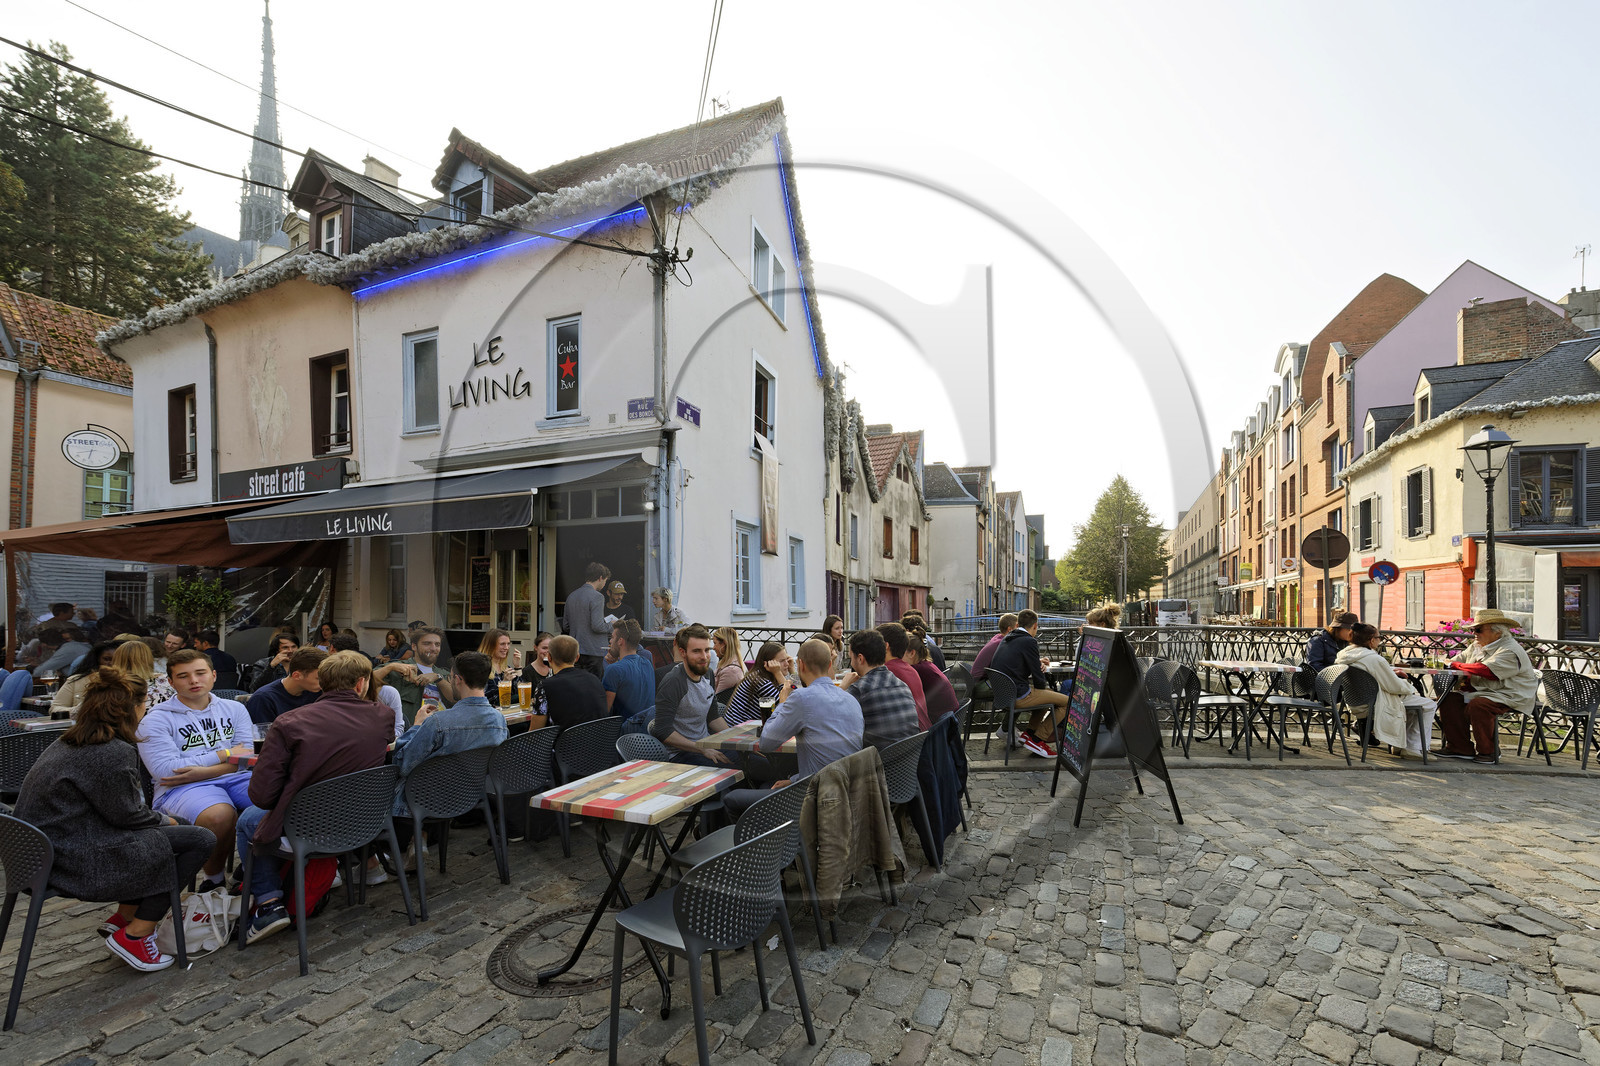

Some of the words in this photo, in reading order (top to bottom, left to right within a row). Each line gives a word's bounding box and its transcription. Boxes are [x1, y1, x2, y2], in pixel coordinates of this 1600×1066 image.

[473, 335, 505, 368] LE
[557, 341, 579, 355] Cuba
[448, 366, 532, 410] LIVING
[560, 379, 576, 391] Bar
[66, 438, 99, 446] STREET
[249, 469, 280, 497] street
[281, 465, 306, 494] café
[326, 518, 342, 536] LE
[346, 512, 393, 535] LIVING
[178, 717, 233, 737] ORIINLS
